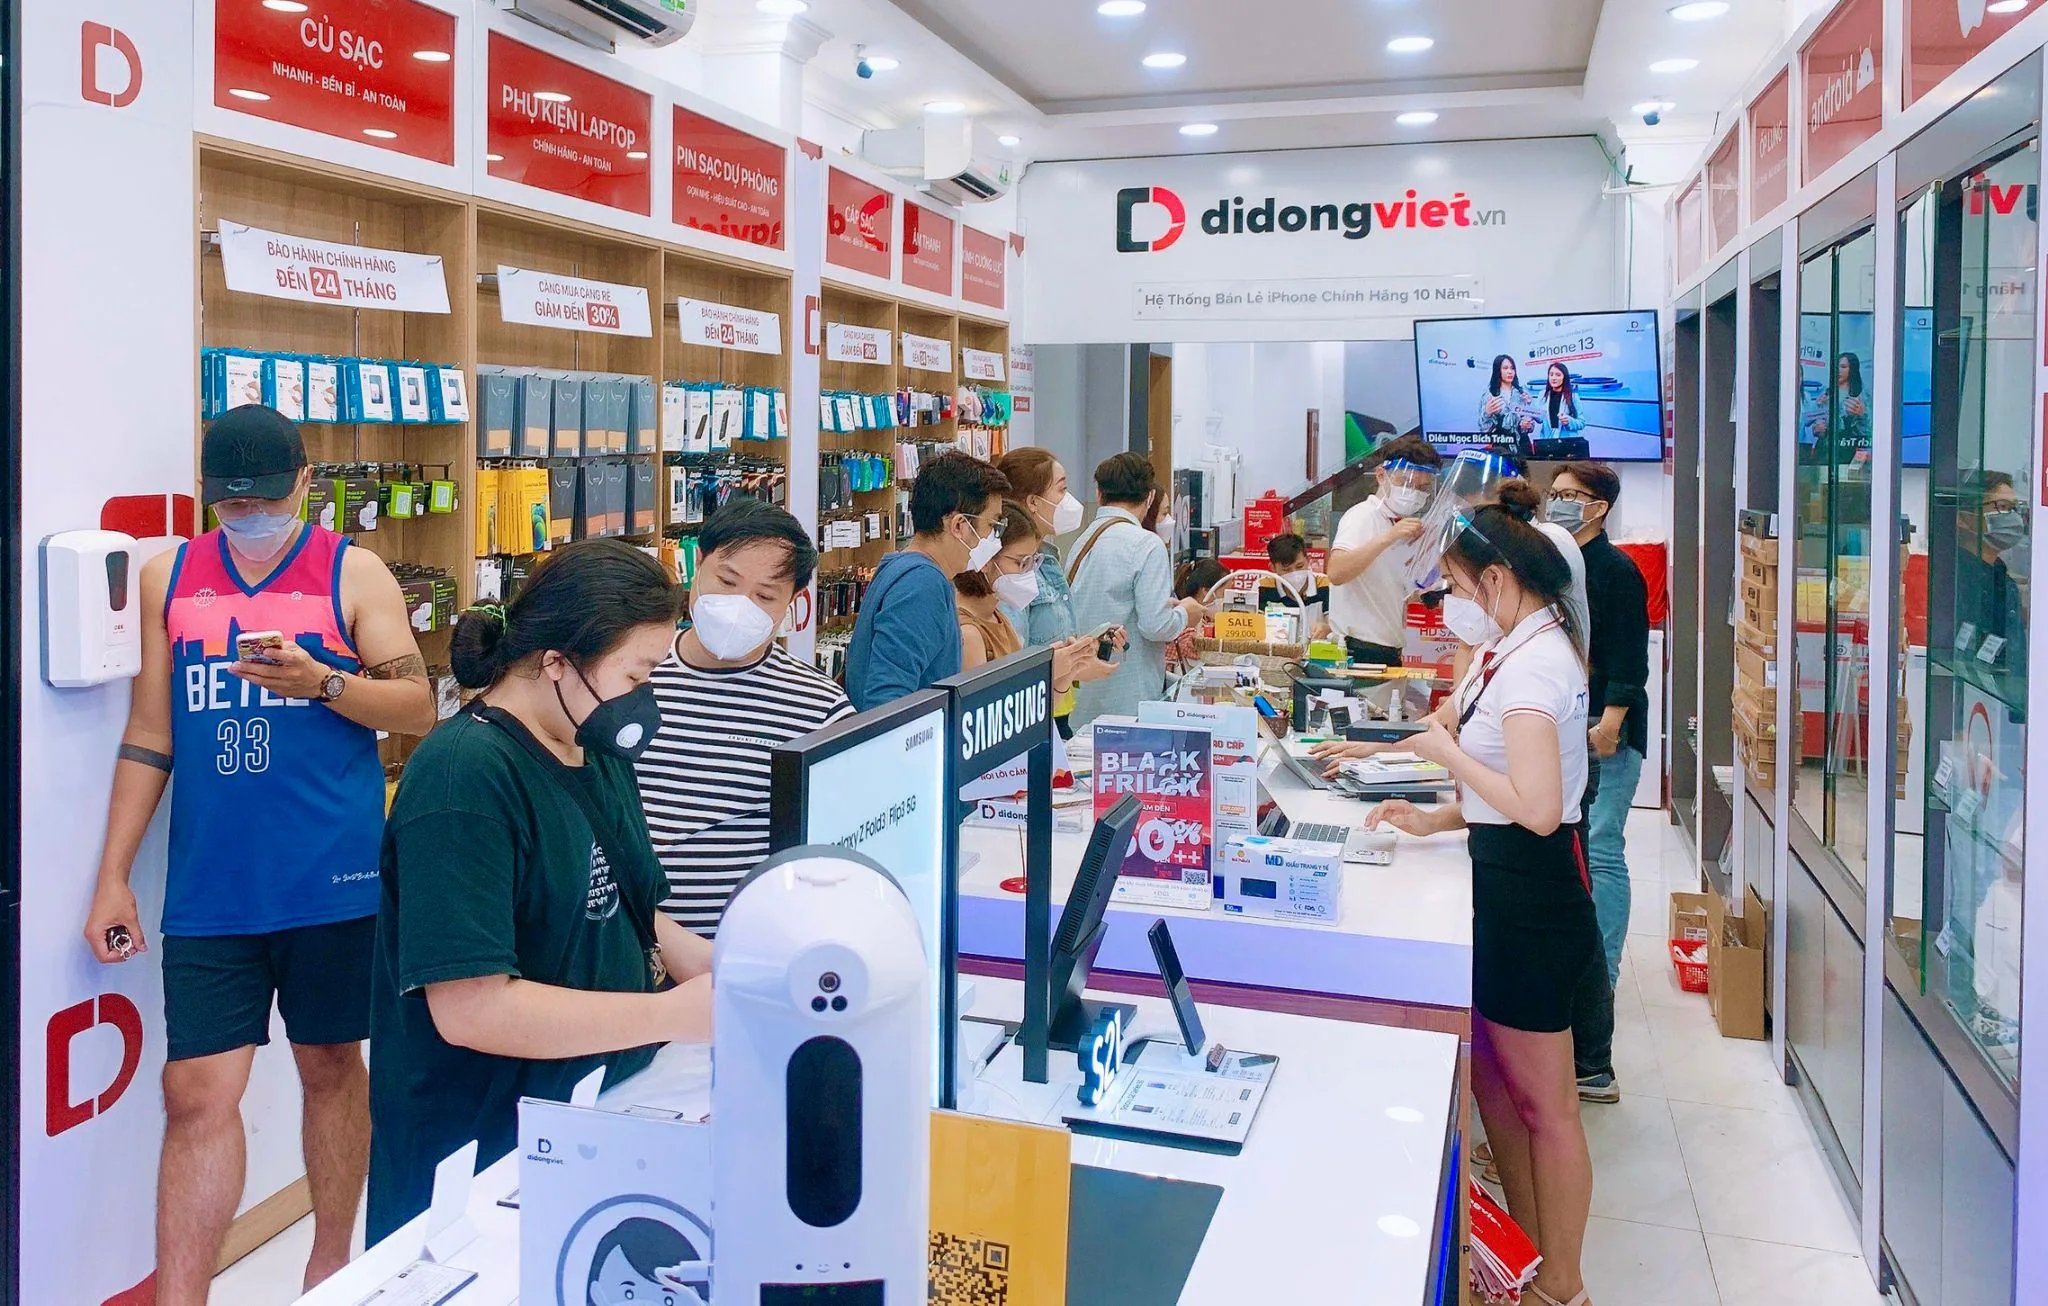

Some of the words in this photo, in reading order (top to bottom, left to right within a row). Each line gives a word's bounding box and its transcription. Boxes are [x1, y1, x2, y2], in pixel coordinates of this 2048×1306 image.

[300, 14, 334, 53] CỦ
[338, 30, 384, 71] SẠC
[272, 61, 314, 85] NHANH
[362, 88, 377, 104] AN
[379, 93, 406, 112] TOÀN
[1810, 54, 1855, 134] android
[502, 84, 538, 124] PHỤ
[580, 112, 636, 150] LAPTOP
[582, 153, 593, 167] AN
[677, 144, 697, 171] PIN
[699, 153, 722, 180] SẠC
[741, 163, 779, 197] PHÒNG
[292, 245, 324, 264] HÀNH
[326, 251, 362, 269] CHÍNH
[276, 264, 308, 291] ĐẾN
[313, 271, 339, 297] 24
[344, 277, 397, 301] THÁNG
[561, 284, 579, 298] MUA
[1145, 291, 1164, 309] Hệ
[1268, 290, 1318, 304] iPhone
[1322, 289, 1364, 303] Chính
[1414, 288, 1430, 301] 10
[1435, 287, 1471, 300] Năm
[564, 301, 585, 321] ĐẾN
[590, 305, 617, 326] 30%
[721, 326, 734, 343] 24
[736, 328, 759, 345] THÁNG
[1537, 341, 1577, 358] iPhone
[1578, 336, 1595, 351] 13
[1449, 433, 1472, 445] Ngọc
[1472, 433, 1491, 443] Bích
[1228, 617, 1253, 628] SALE
[962, 680, 1047, 761] SAMSUNG
[217, 718, 271, 775] 33
[905, 726, 934, 751] SAMSUNG
[859, 823, 865, 843] Z
[865, 811, 886, 840] Fold3
[889, 800, 906, 827] Flip3
[906, 794, 917, 815] 5G
[1265, 853, 1284, 867] MD
[1300, 862, 1318, 870] TRANG
[1091, 1007, 1122, 1105] S21
[527, 1154, 564, 1165] didongviet
